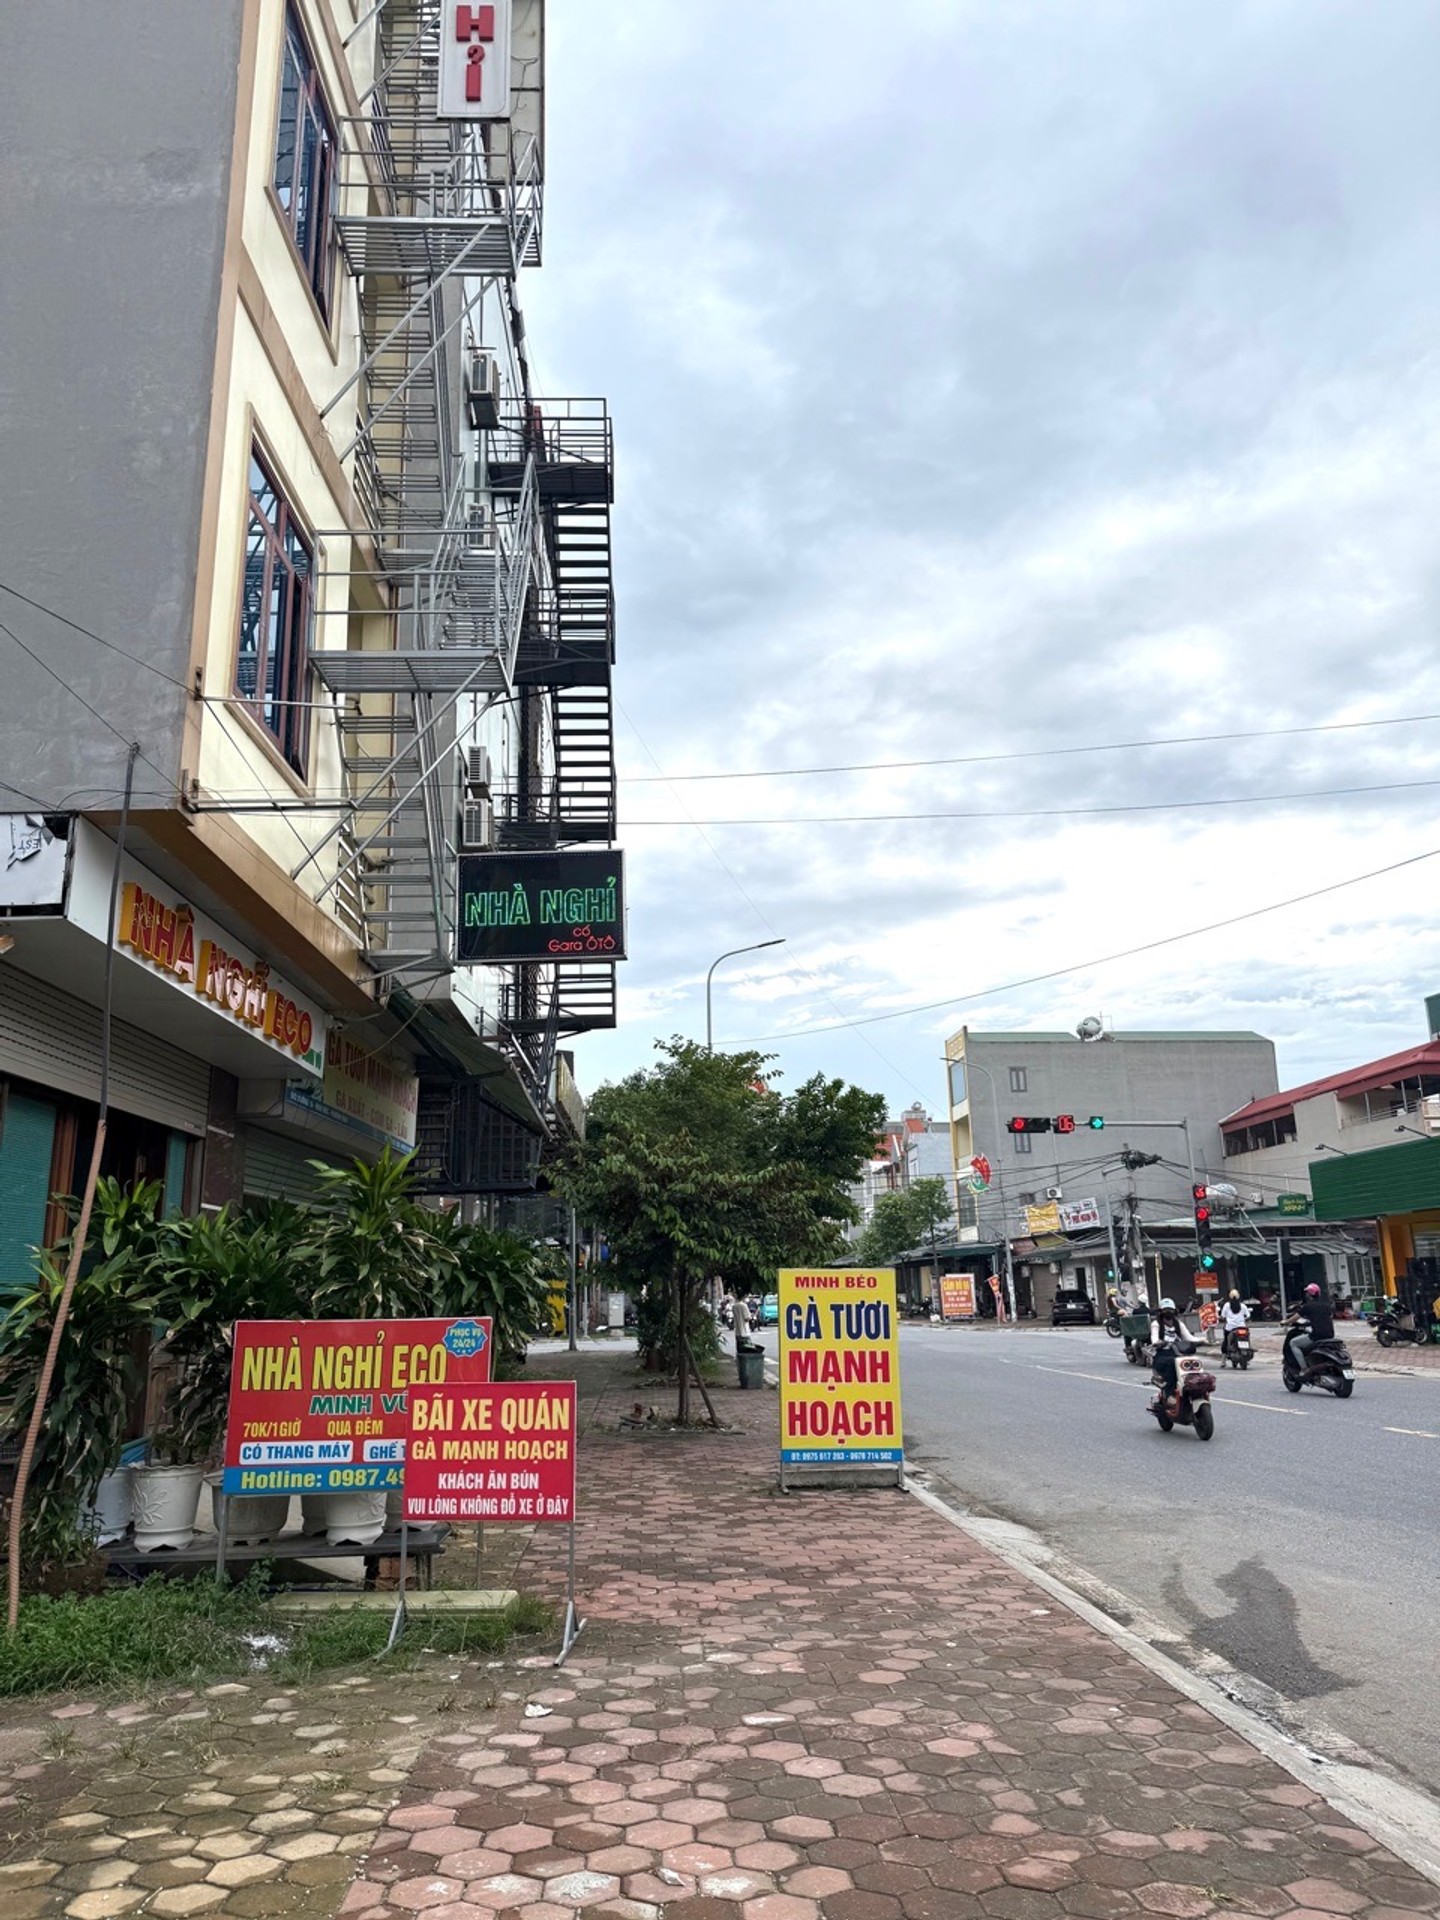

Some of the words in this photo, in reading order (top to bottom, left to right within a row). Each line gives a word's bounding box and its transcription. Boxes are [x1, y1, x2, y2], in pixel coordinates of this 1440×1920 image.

[464, 882, 531, 927] NHÀ
[540, 875, 617, 924] NGHỈ
[548, 938, 583, 952] Gara
[119, 882, 196, 984] NHÀ
[196, 938, 270, 1028] NGHỈ
[263, 989, 312, 1056] ECO
[795, 1276, 839, 1288] MINH
[845, 1275, 877, 1288] BÉO
[785, 1296, 822, 1340] GÀ
[830, 1300, 891, 1340] TƯƠI
[241, 1336, 302, 1391] NHÀ
[312, 1330, 383, 1389] NGHỈ
[391, 1343, 447, 1387] ECO
[788, 1350, 891, 1391] MẠNH
[308, 1394, 373, 1415] MINH
[412, 1392, 455, 1431] BÃI
[461, 1398, 493, 1431] XE
[500, 1391, 570, 1434] QUÁN
[243, 1417, 302, 1438] 70K/1GIỜ
[326, 1420, 352, 1437] QUA
[355, 1416, 384, 1436] ĐÊM
[788, 1400, 894, 1444] HOẠCH
[242, 1443, 262, 1460] CÓ
[267, 1445, 314, 1459] THANG
[318, 1441, 351, 1458] MÁY
[369, 1440, 399, 1459] GHẾ
[412, 1437, 437, 1460] GÀ
[443, 1440, 499, 1464] MẠNH
[504, 1440, 568, 1464] HOẠCH
[241, 1470, 322, 1489] Hotline:
[438, 1469, 484, 1490] KHÁCH
[487, 1469, 507, 1490] ĂN
[510, 1469, 539, 1490] BÚN
[408, 1498, 425, 1514] VUI
[428, 1494, 457, 1515] LÒNG
[460, 1494, 498, 1515] KHÔNG
[500, 1492, 516, 1515] ĐỖ
[518, 1498, 533, 1515] XE
[536, 1493, 545, 1515] Ở
[546, 1494, 569, 1515] ĐÂY
